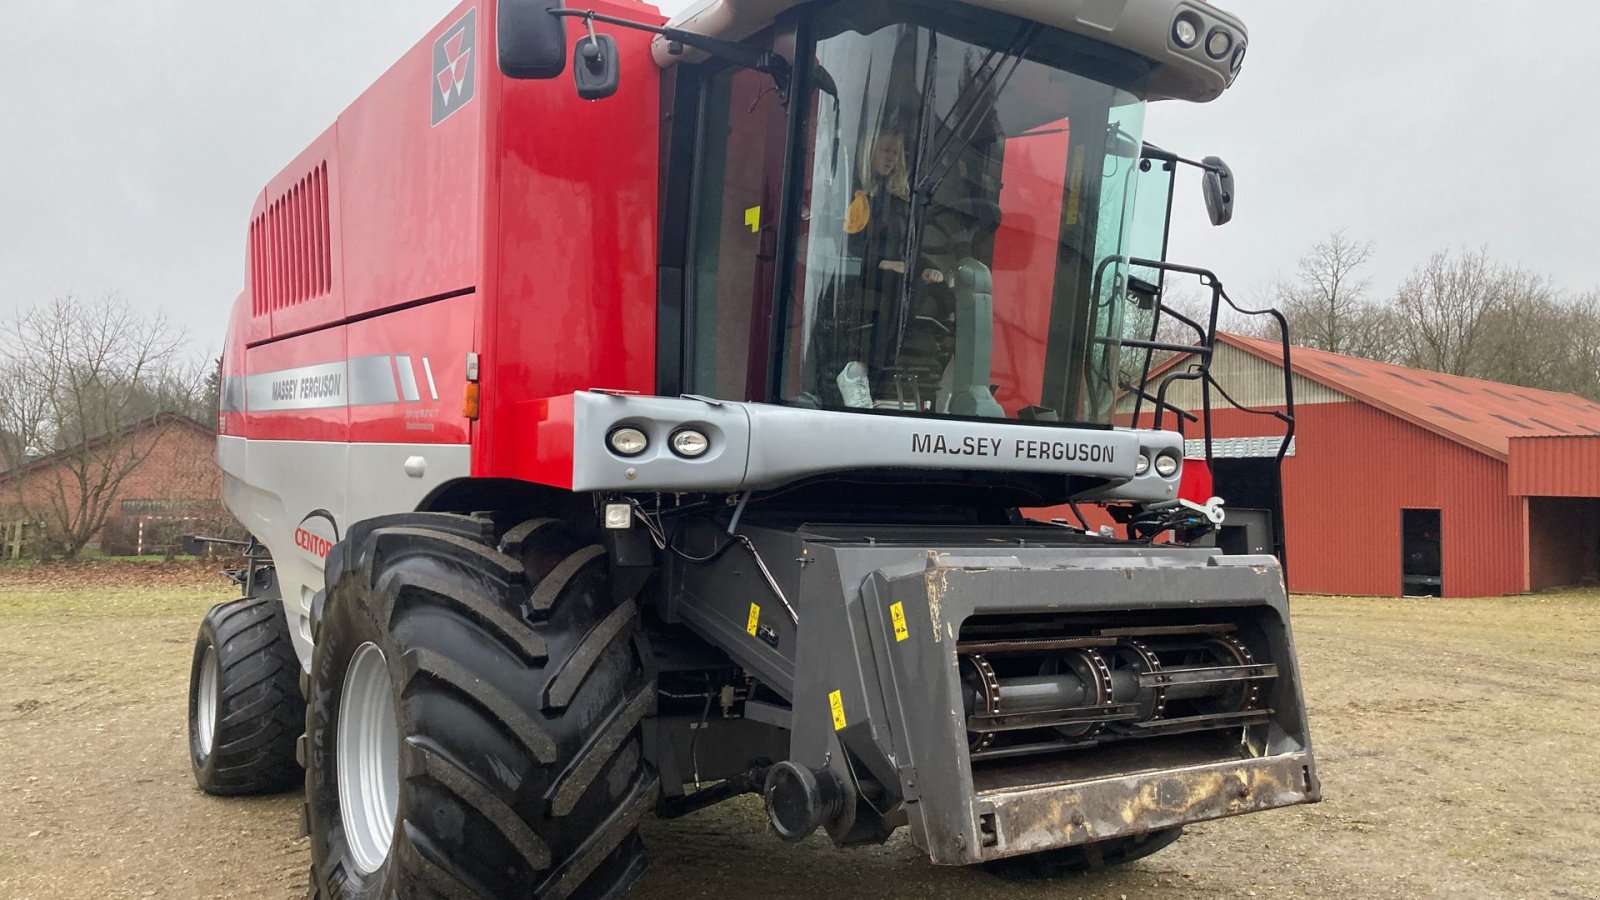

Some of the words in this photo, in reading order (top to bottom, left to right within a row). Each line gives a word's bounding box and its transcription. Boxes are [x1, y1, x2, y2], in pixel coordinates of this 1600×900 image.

[272, 379, 298, 401] MASSEY
[299, 373, 341, 399] FERGUSON
[911, 433, 1002, 456] MASEY
[1015, 439, 1114, 463] FERGUSON
